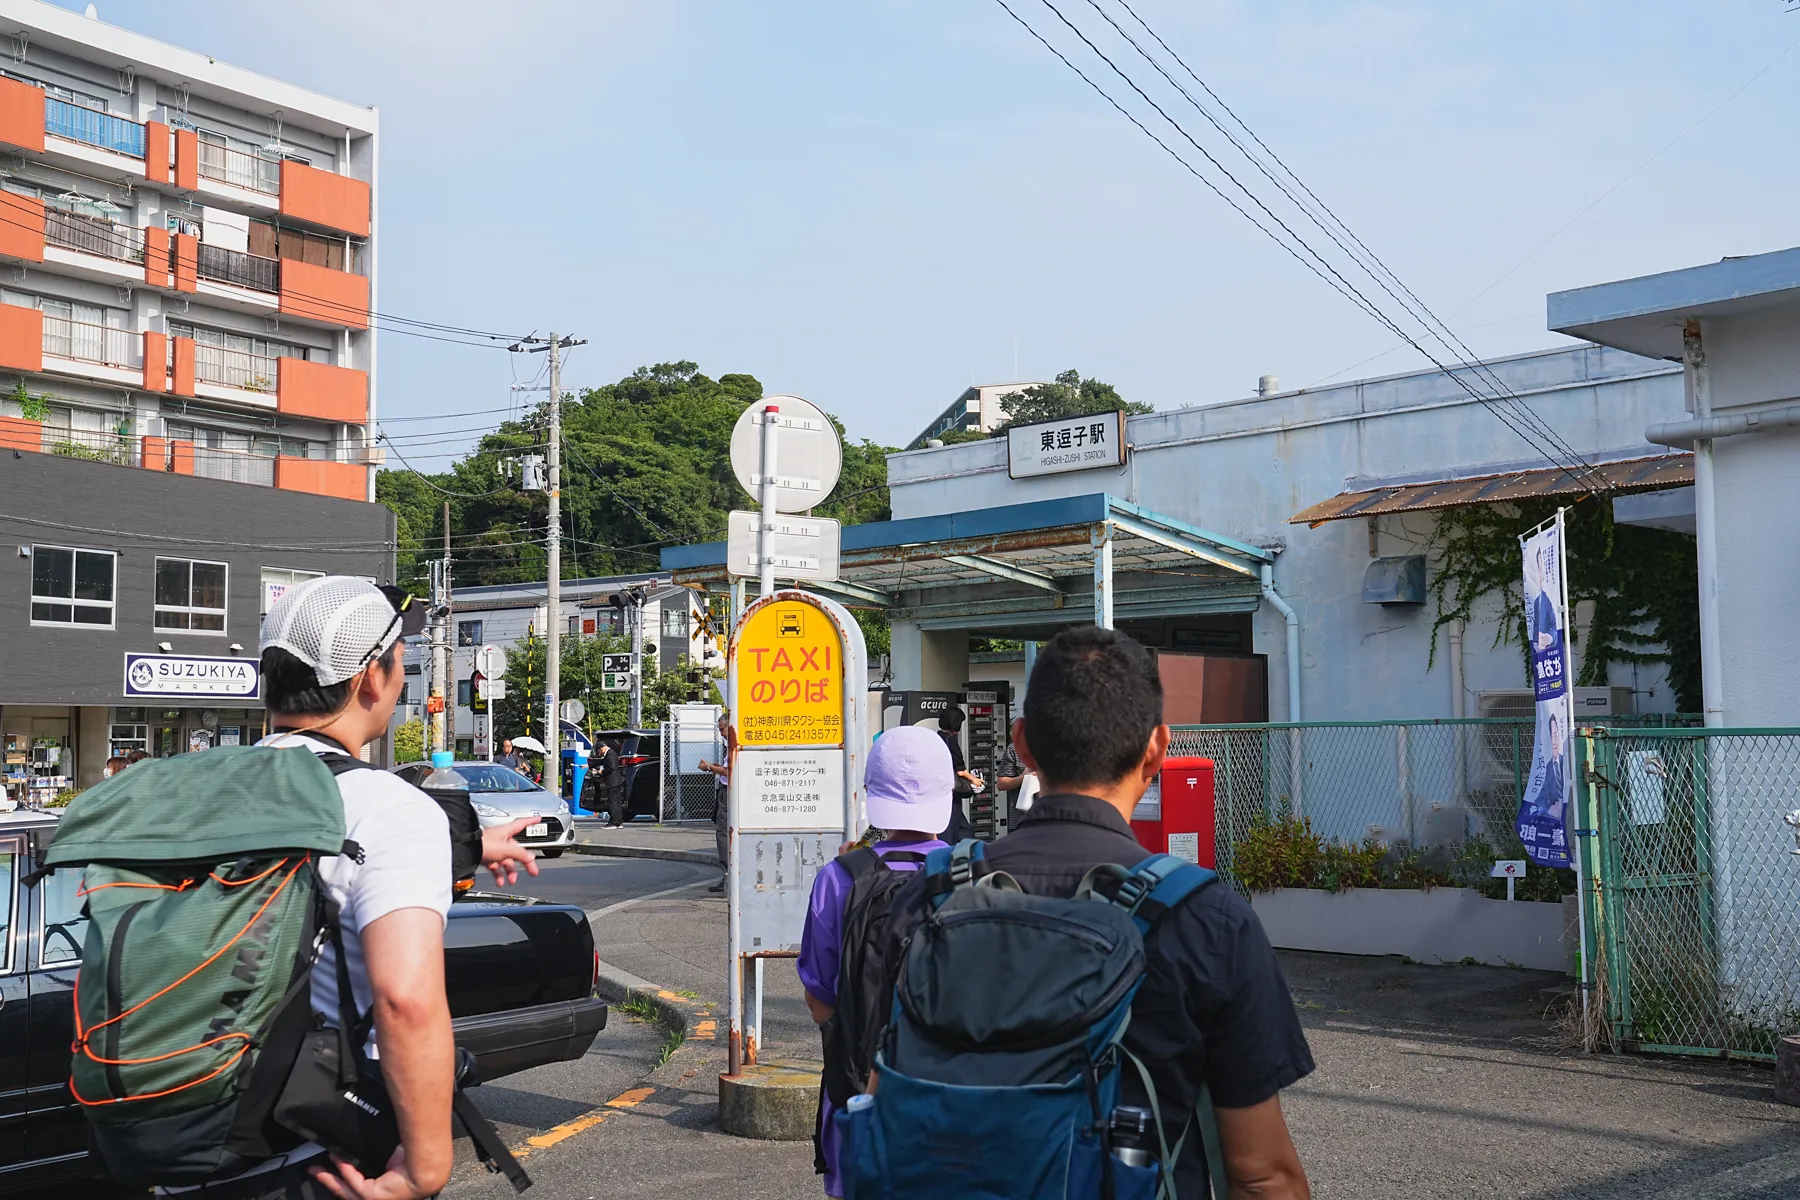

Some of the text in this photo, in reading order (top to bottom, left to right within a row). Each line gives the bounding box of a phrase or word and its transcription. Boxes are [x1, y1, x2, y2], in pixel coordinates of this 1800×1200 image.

[1040, 422, 1105, 452] 東逗子駅
[1040, 454, 1081, 467] HIGASHI-ZUSHI
[1084, 449, 1106, 461] STATION
[748, 646, 831, 672] TAXI
[159, 663, 246, 679] SUZUKIYA
[158, 683, 246, 692] MARKET
[751, 677, 829, 704] のりば
[920, 701, 948, 709] acure
[743, 714, 840, 728] (社)神奈川県タクシー協会
[744, 729, 838, 741] 電話045(241)3577
[764, 779, 816, 787] 046-871-2117
[764, 805, 817, 813] 046-877-1280
[343, 1090, 380, 1117] MAMMUT
